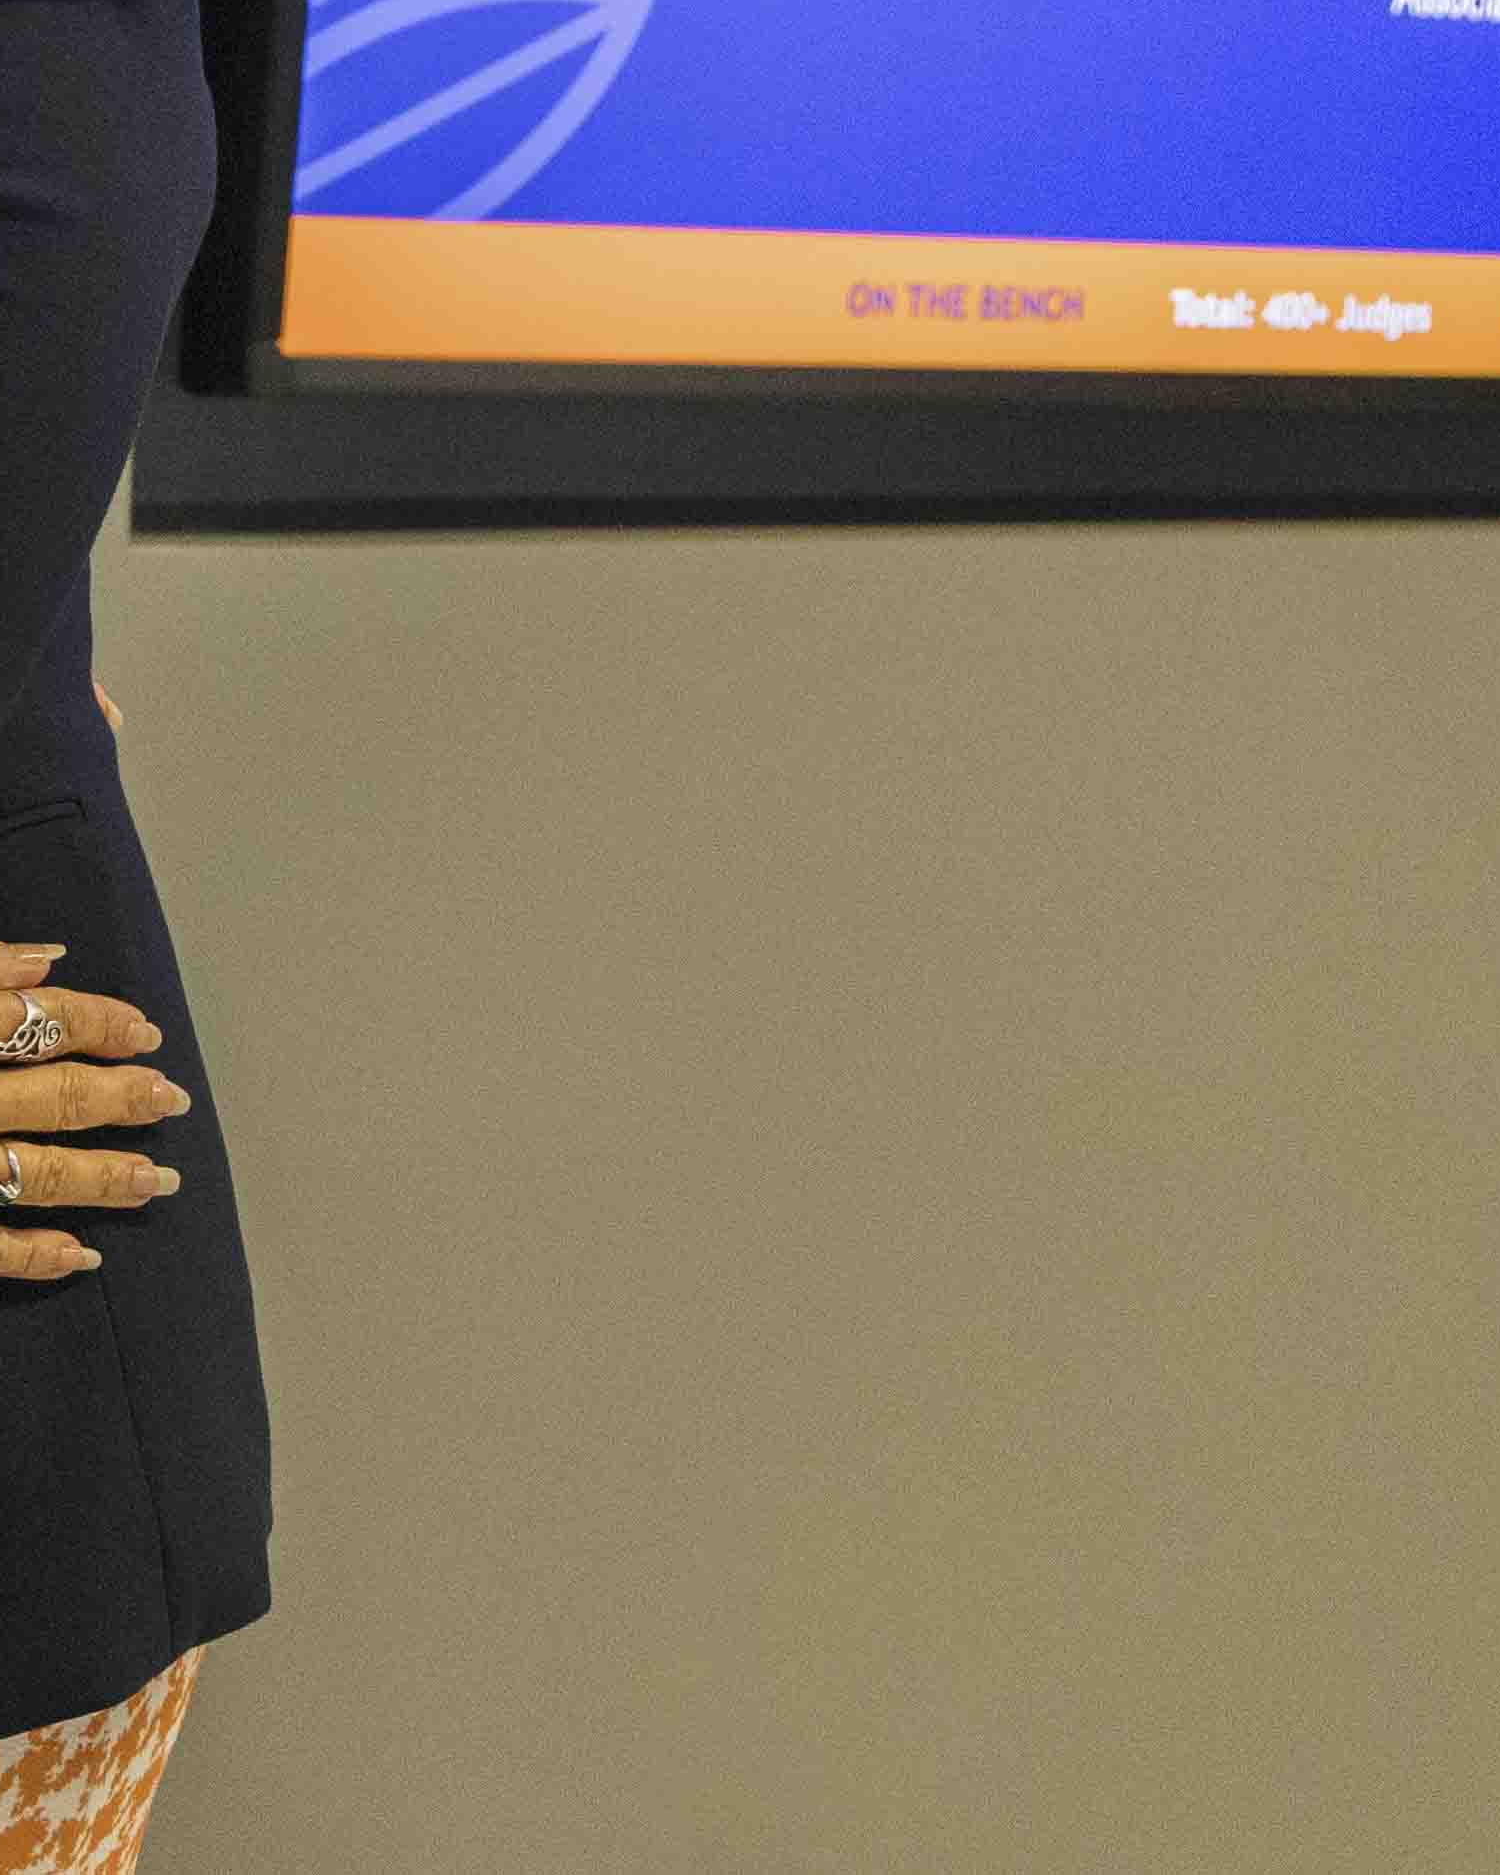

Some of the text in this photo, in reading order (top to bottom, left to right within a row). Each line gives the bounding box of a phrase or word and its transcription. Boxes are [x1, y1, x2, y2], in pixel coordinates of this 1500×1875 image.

[846, 283, 1085, 322] ON THE BENCH
[1335, 293, 1433, 342] Judges
